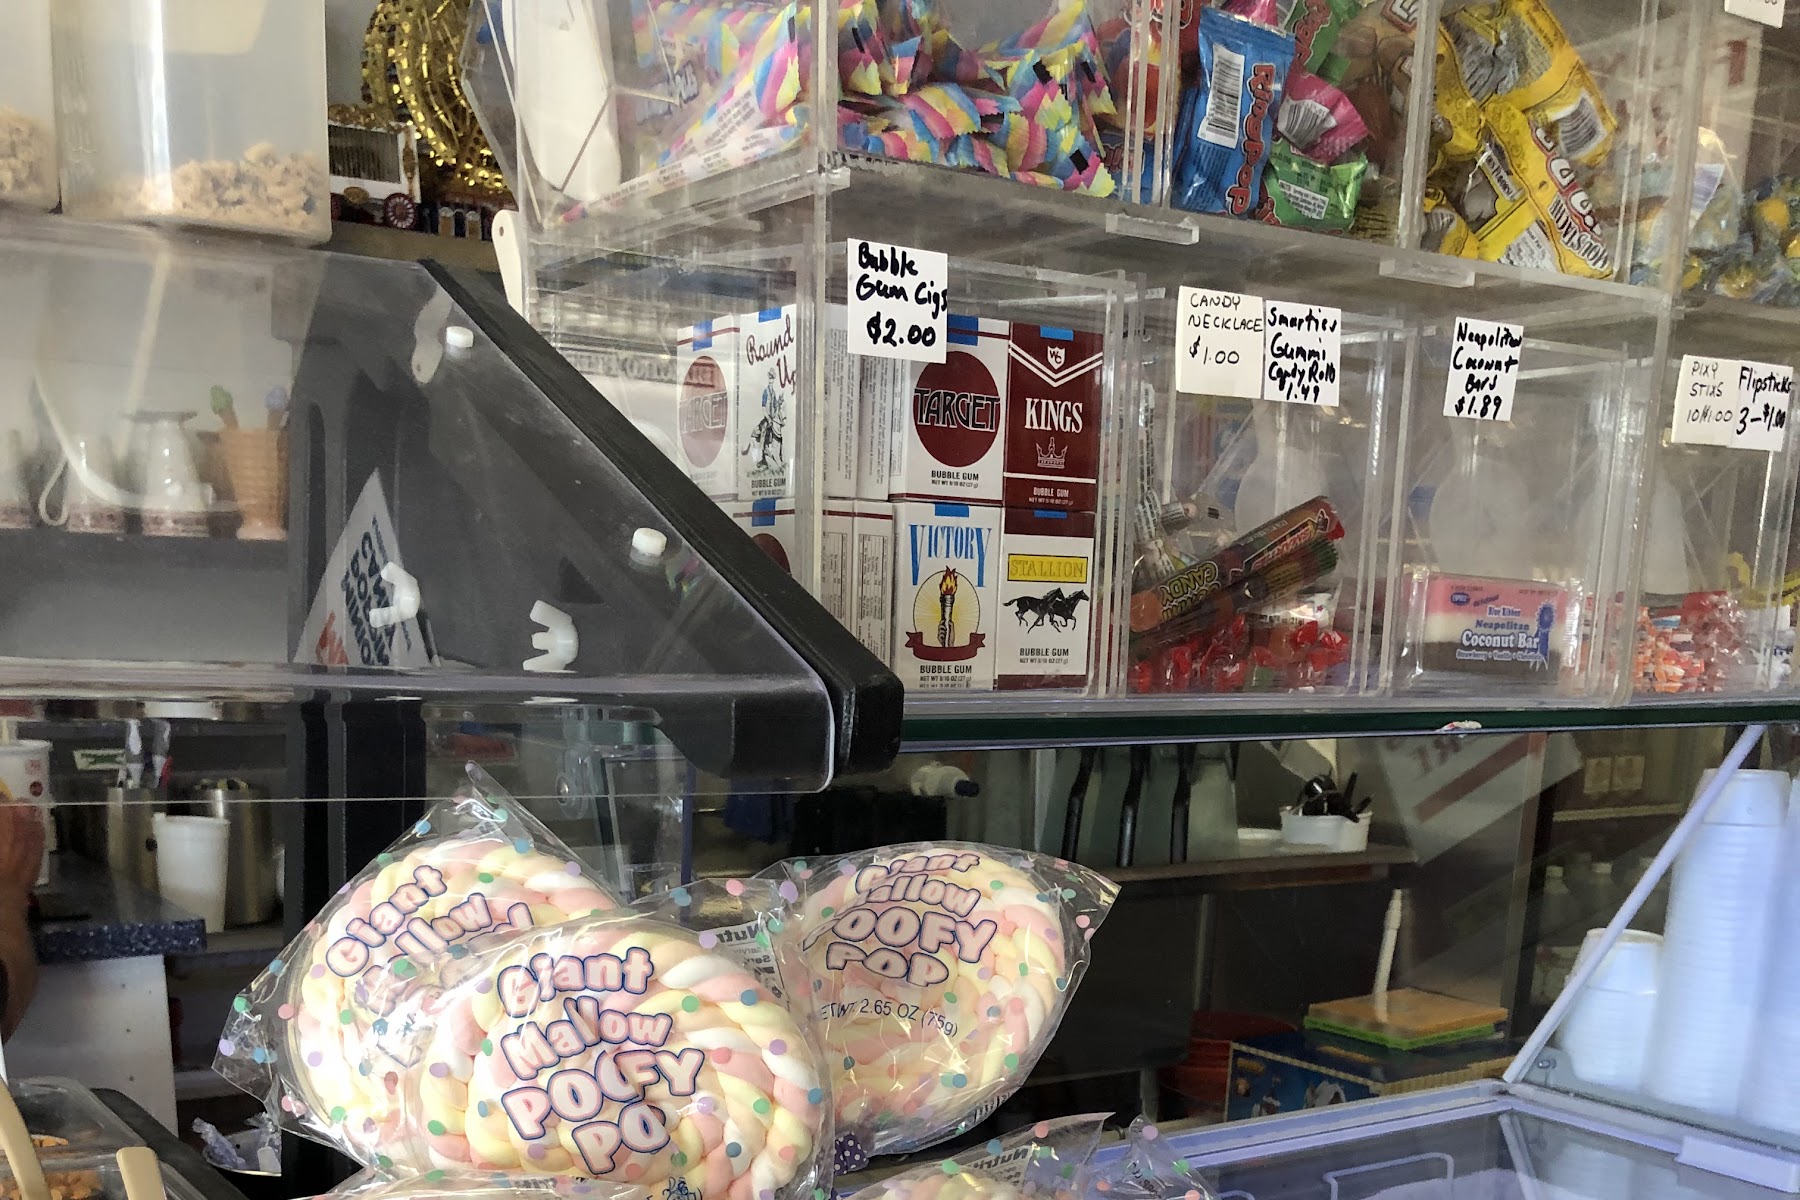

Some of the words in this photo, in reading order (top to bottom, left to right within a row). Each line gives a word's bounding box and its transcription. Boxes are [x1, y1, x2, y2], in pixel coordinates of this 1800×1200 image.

[858, 242, 918, 277] Bubble
[856, 273, 908, 302] Gum
[1190, 293, 1241, 311] CANDY
[866, 312, 937, 347] $2.00
[1188, 314, 1263, 332] NECKLACE
[1268, 307, 1337, 332] Smarties
[746, 314, 795, 366] Round
[1189, 335, 1240, 365] $1.00
[1270, 332, 1326, 361] Gummi
[1691, 361, 1718, 379] PIXY
[913, 388, 1001, 432] TARGET
[1024, 397, 1083, 433] KINGS
[1455, 395, 1502, 420] $1.89
[931, 470, 960, 480] BUBBLE
[962, 472, 980, 481] GUM
[1033, 487, 1054, 497] BUBBLE
[1056, 489, 1069, 498] GUM
[908, 524, 992, 588] VICTORY
[1009, 558, 1084, 578] STALLION
[1462, 629, 1515, 648] Coconut
[1517, 632, 1540, 649] Bar
[1475, 620, 1530, 630] Neapolitan
[1019, 648, 1050, 657] BUBBLE
[1051, 648, 1069, 657] GUM
[919, 665, 952, 674] BUBBLE
[954, 665, 972, 674] GUM
[326, 864, 447, 977] Giant
[826, 941, 949, 988] POP
[497, 946, 653, 1018] Giant
[860, 998, 892, 1016] 2.65
[897, 1003, 920, 1021] OZ
[921, 1010, 958, 1037] (75g)
[501, 997, 673, 1080] Mallow
